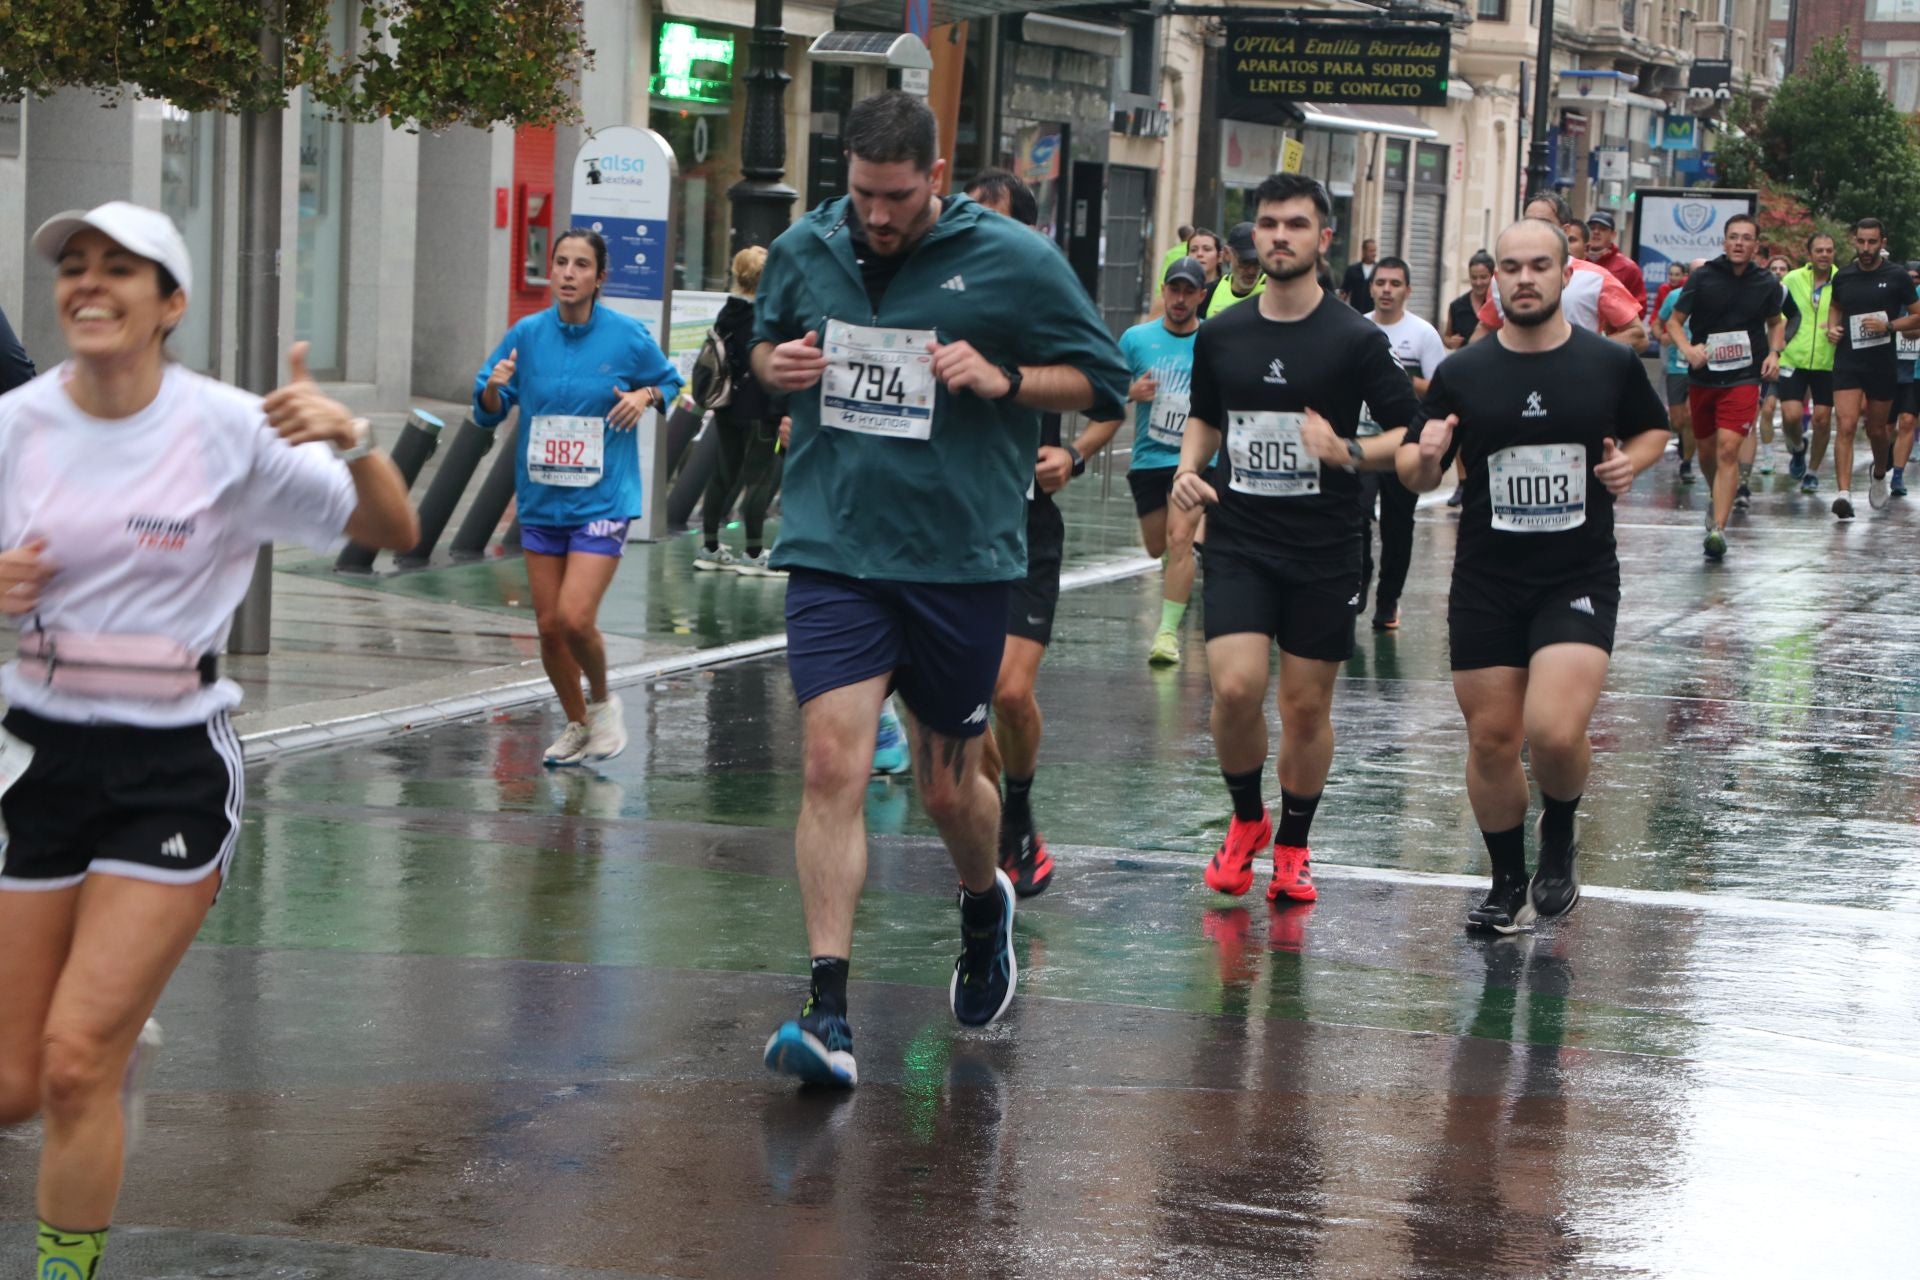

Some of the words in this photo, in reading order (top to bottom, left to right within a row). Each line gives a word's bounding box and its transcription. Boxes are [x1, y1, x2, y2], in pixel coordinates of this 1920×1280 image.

[1233, 36, 1295, 53] OPTICA
[1304, 38, 1361, 56] Emilia
[1367, 40, 1441, 58] Barriada
[1237, 59, 1318, 74] APARATOS
[1323, 61, 1365, 76] PARA
[1371, 63, 1436, 78] SORDOS
[1249, 79, 1307, 94] LENTES
[1313, 81, 1334, 95] DE
[1340, 82, 1421, 98] CONTACTO
[600, 154, 645, 173] alsa
[1715, 343, 1744, 361] 1080
[847, 361, 906, 404] 794
[544, 439, 585, 466] 982
[1248, 441, 1297, 471] 805
[1507, 474, 1569, 505] 1003
